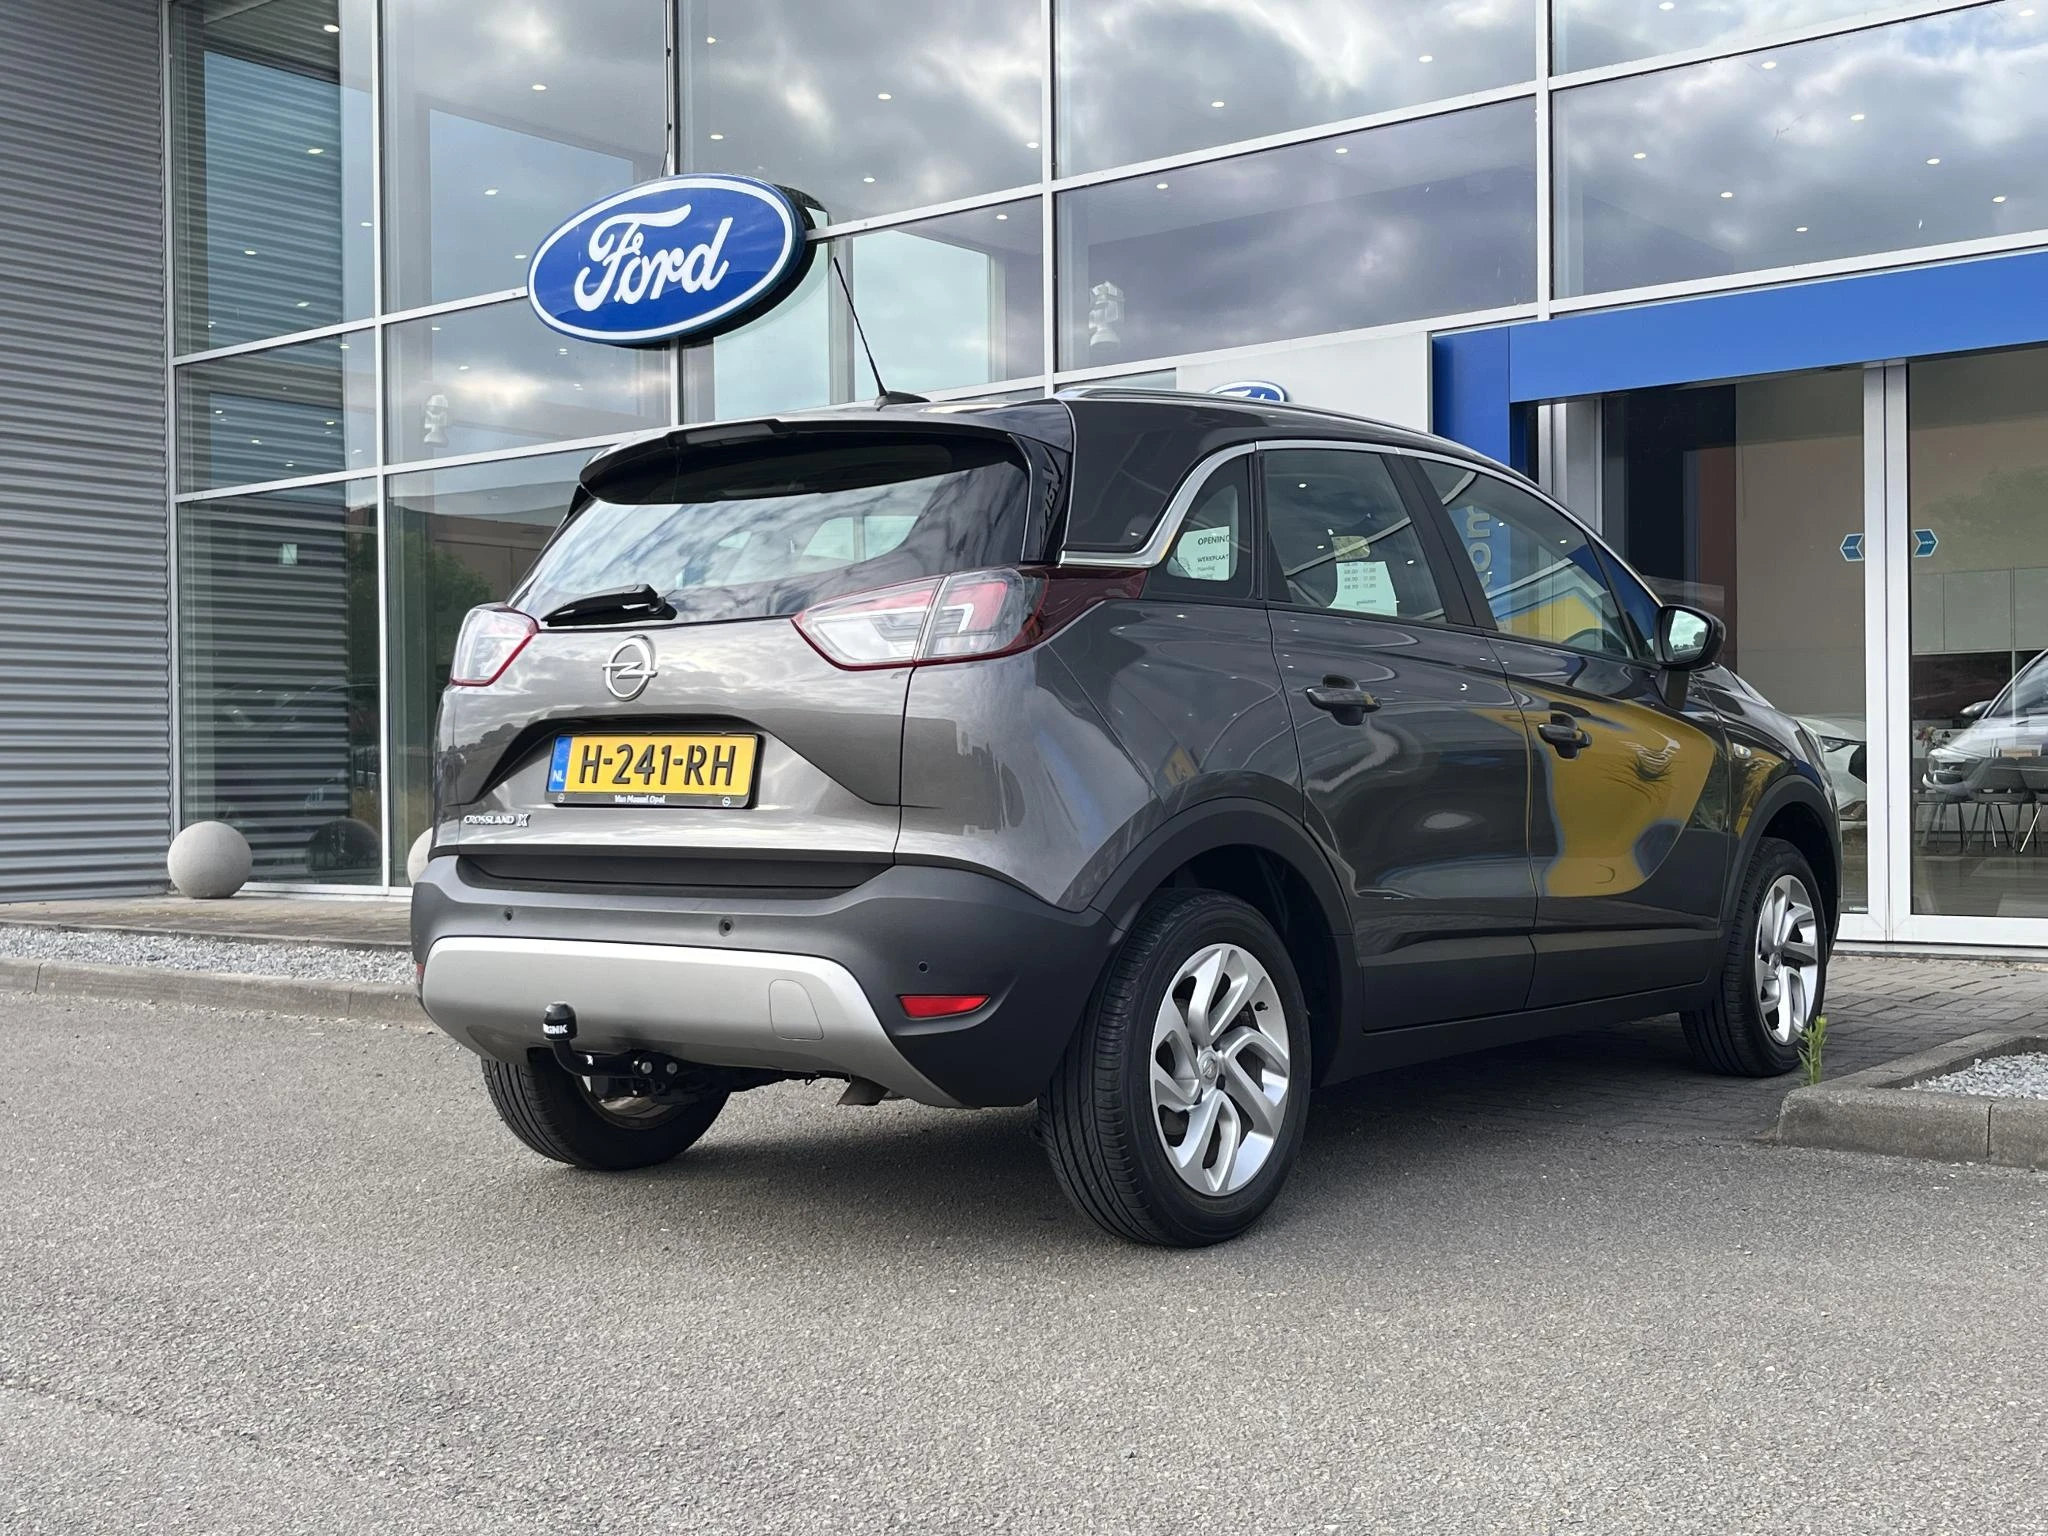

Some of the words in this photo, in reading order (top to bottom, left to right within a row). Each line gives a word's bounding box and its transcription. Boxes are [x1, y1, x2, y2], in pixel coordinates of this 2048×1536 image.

[574, 204, 733, 312] Ford
[578, 743, 737, 786] H-241-RH
[552, 769, 564, 782] NL
[649, 795, 666, 805] Opel
[463, 814, 516, 825] CROSSLAND
[516, 813, 530, 828] X
